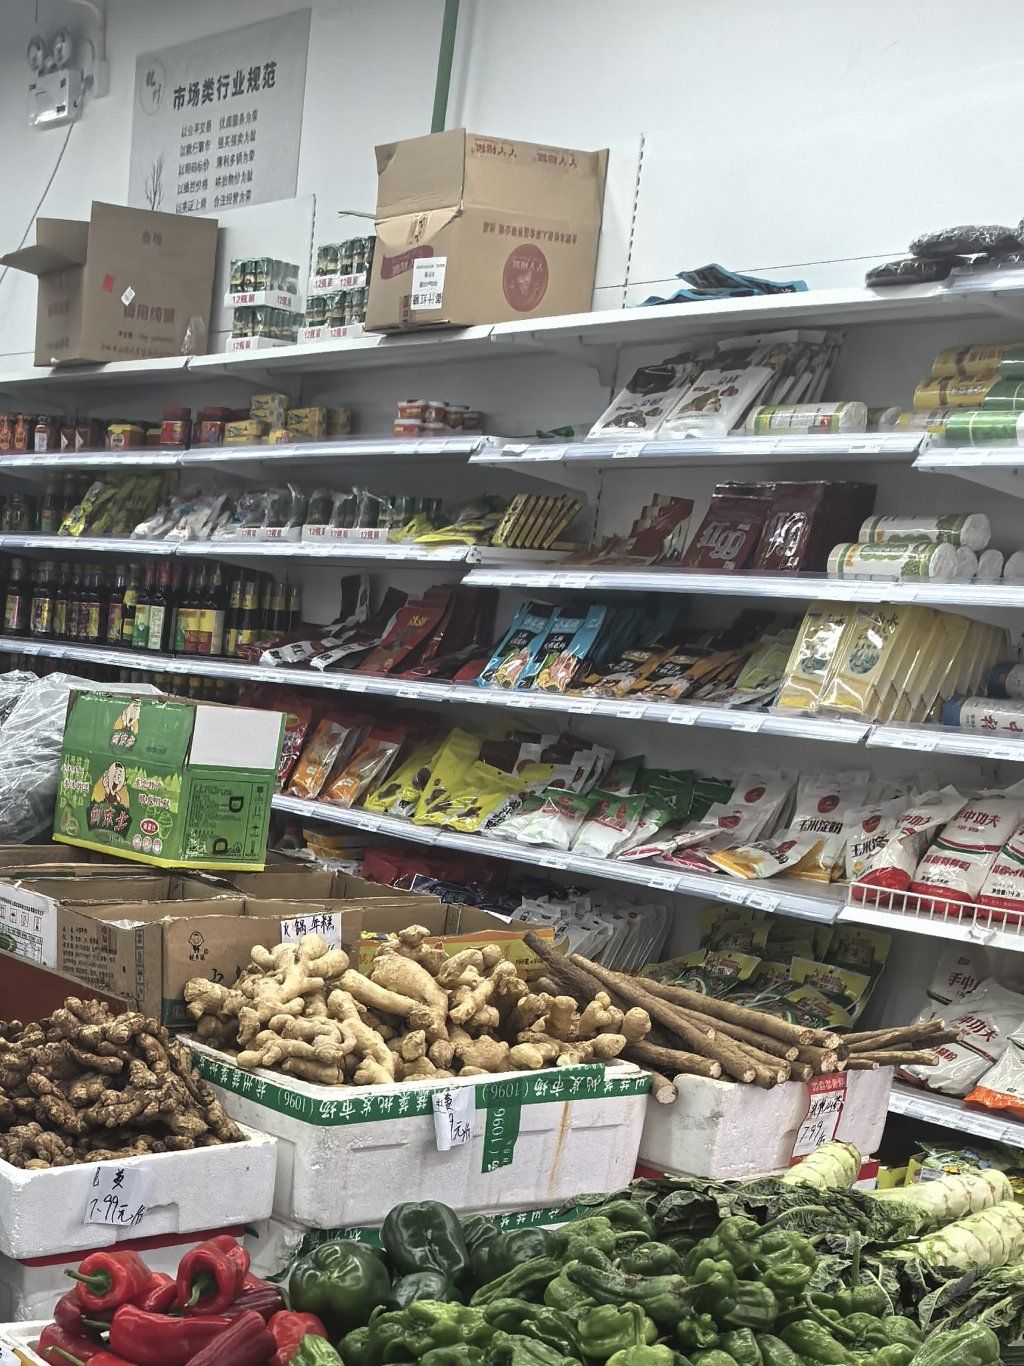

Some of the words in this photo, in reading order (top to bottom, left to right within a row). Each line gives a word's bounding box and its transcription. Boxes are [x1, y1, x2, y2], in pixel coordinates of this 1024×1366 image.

[173, 61, 277, 110] 市场类行业规范
[798, 817, 845, 835] 玉米淀粉
[283, 915, 335, 938] 火锅年糕
